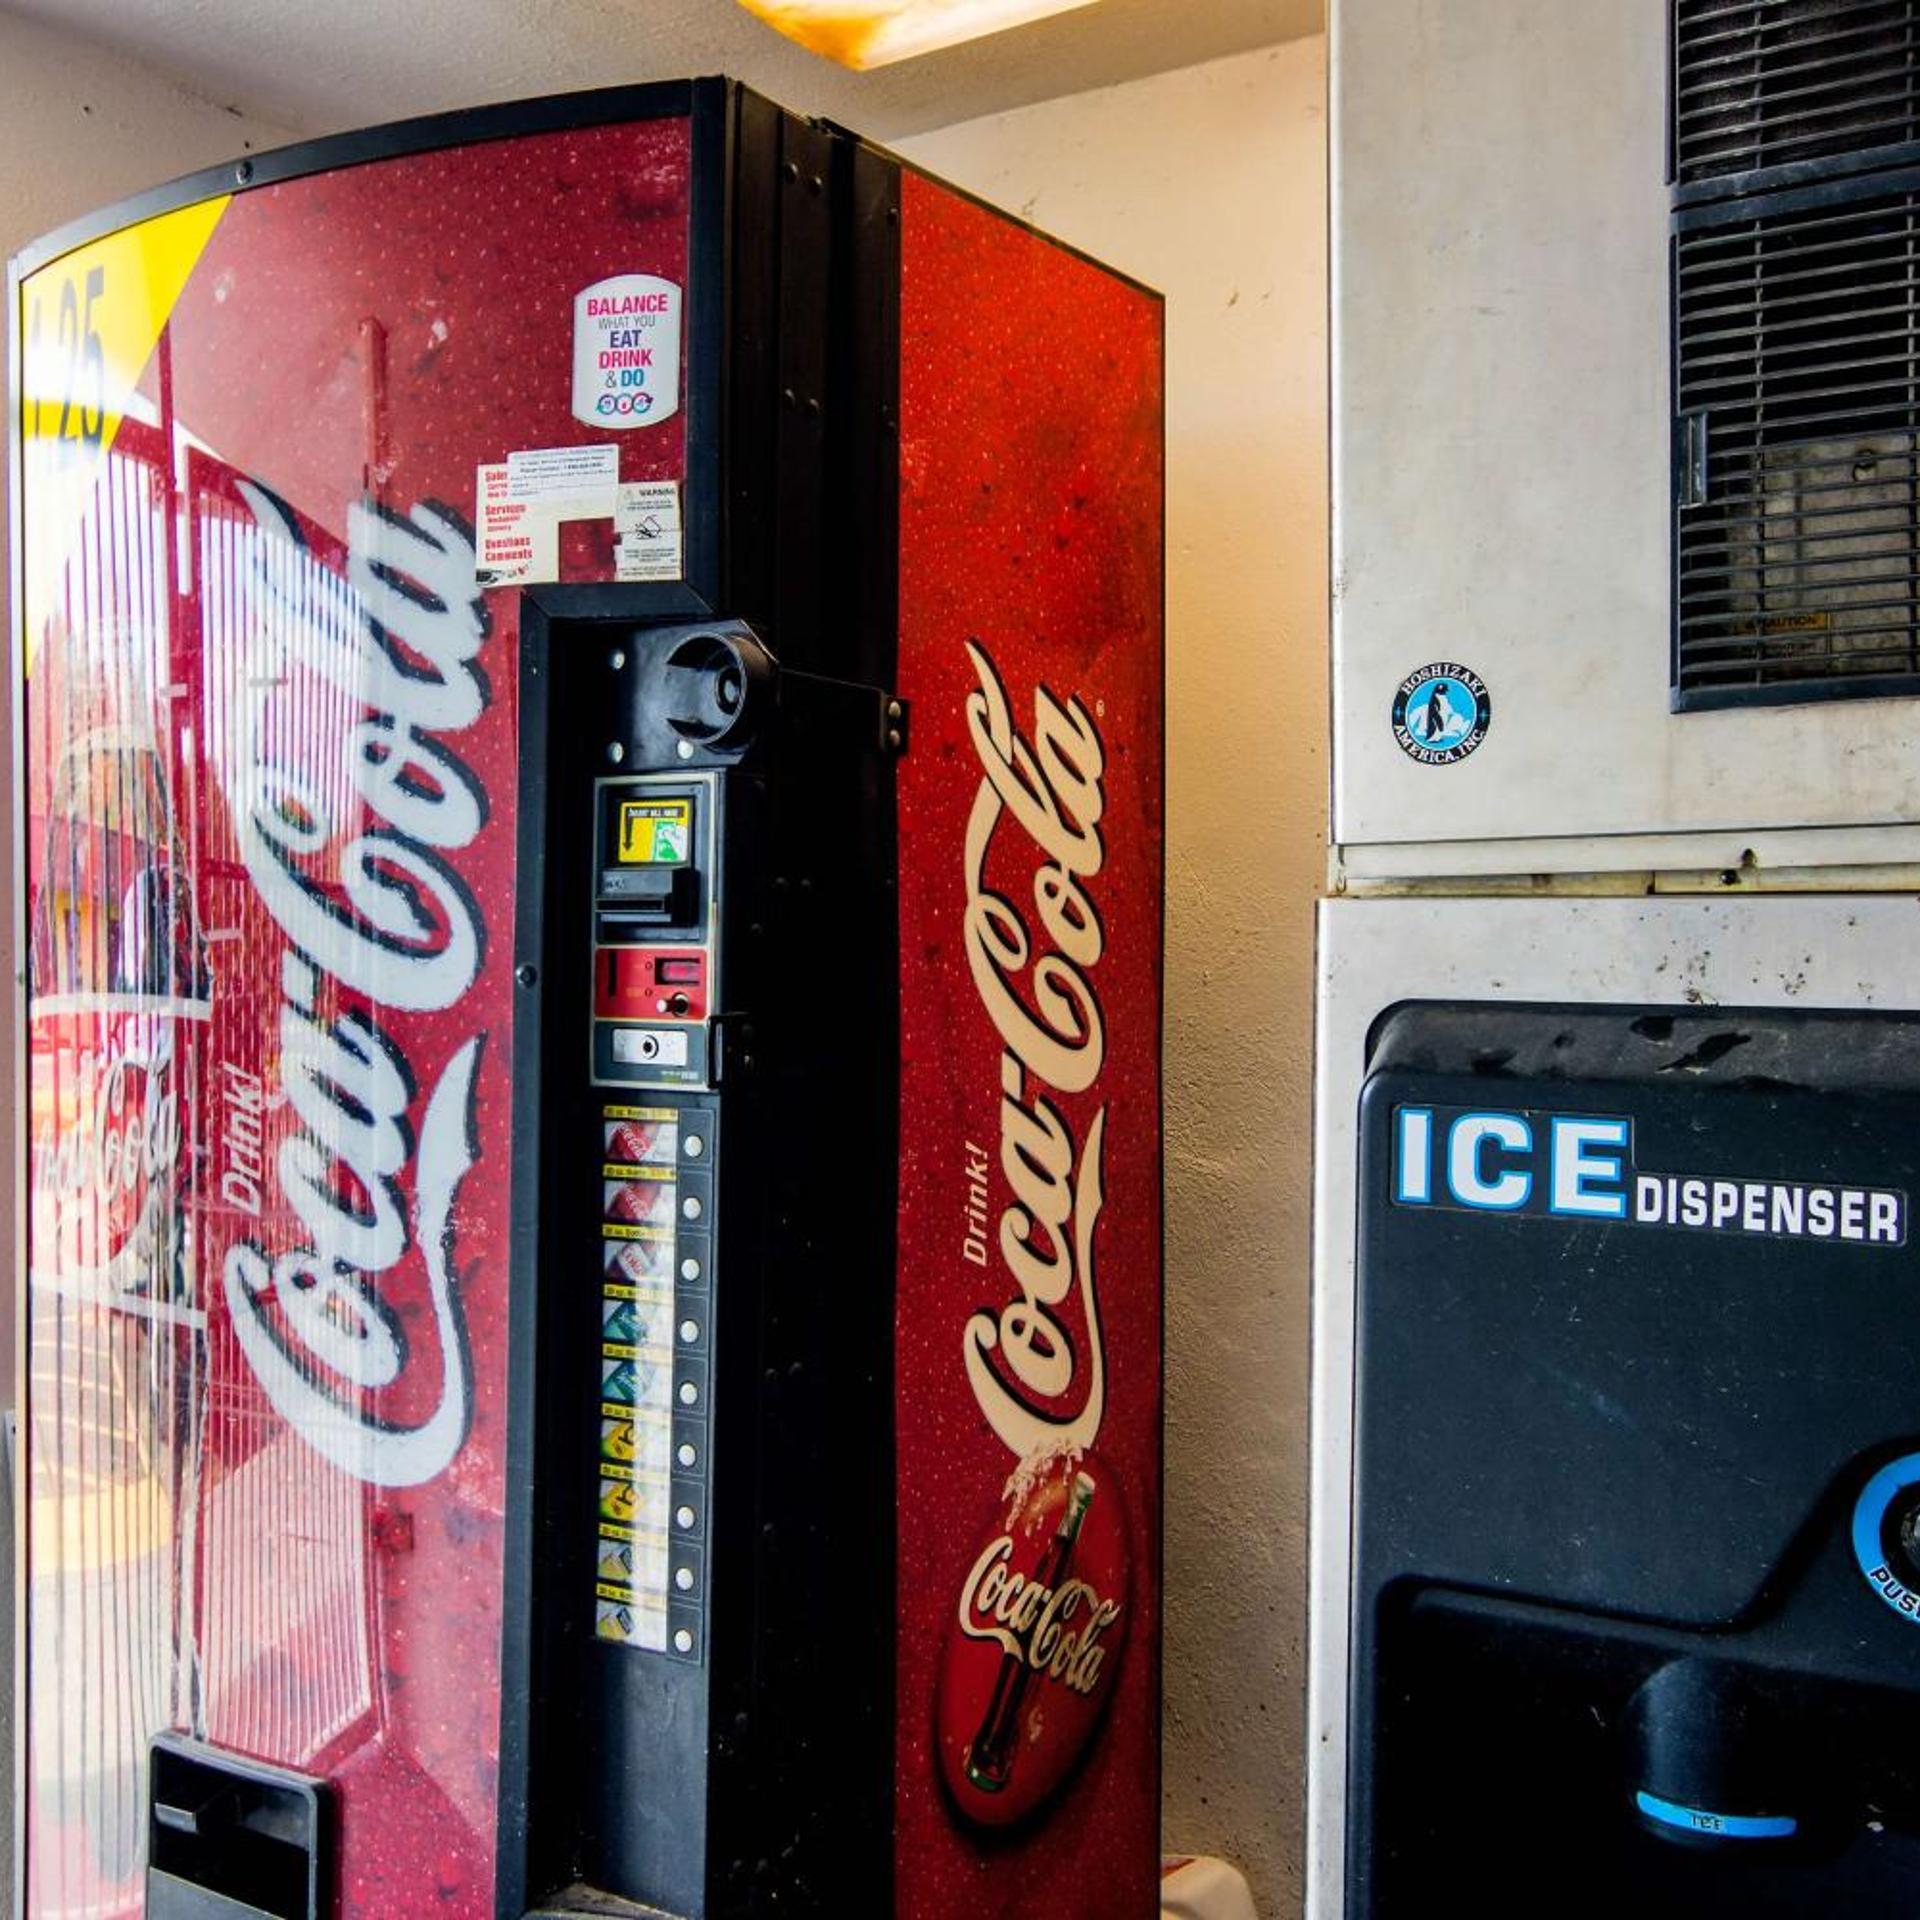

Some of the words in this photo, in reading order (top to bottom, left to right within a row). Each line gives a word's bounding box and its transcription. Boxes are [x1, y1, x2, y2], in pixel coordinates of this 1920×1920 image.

[587, 293, 668, 316] BALANCE
[598, 316, 631, 329] WHAT
[633, 314, 656, 328] YOU
[610, 329, 642, 348] EAT
[598, 349, 653, 369] DRINK
[605, 370, 617, 388] &
[621, 368, 645, 387] DO
[485, 504, 526, 515] Services
[485, 537, 531, 549] Questions
[485, 549, 533, 561] Comments
[1401, 663, 1488, 697] HOSHIZAKI
[964, 637, 1106, 1460] Coca-Cola
[223, 1061, 264, 1216] Drink!
[1400, 1108, 1628, 1218] ICE
[1636, 1176, 1898, 1242] DISPENSER
[963, 1140, 989, 1268] Drink!
[1870, 1566, 1920, 1621] PUS
[959, 1536, 1121, 1695] Coca-Cola
[1691, 1813, 1723, 1830] ICE
